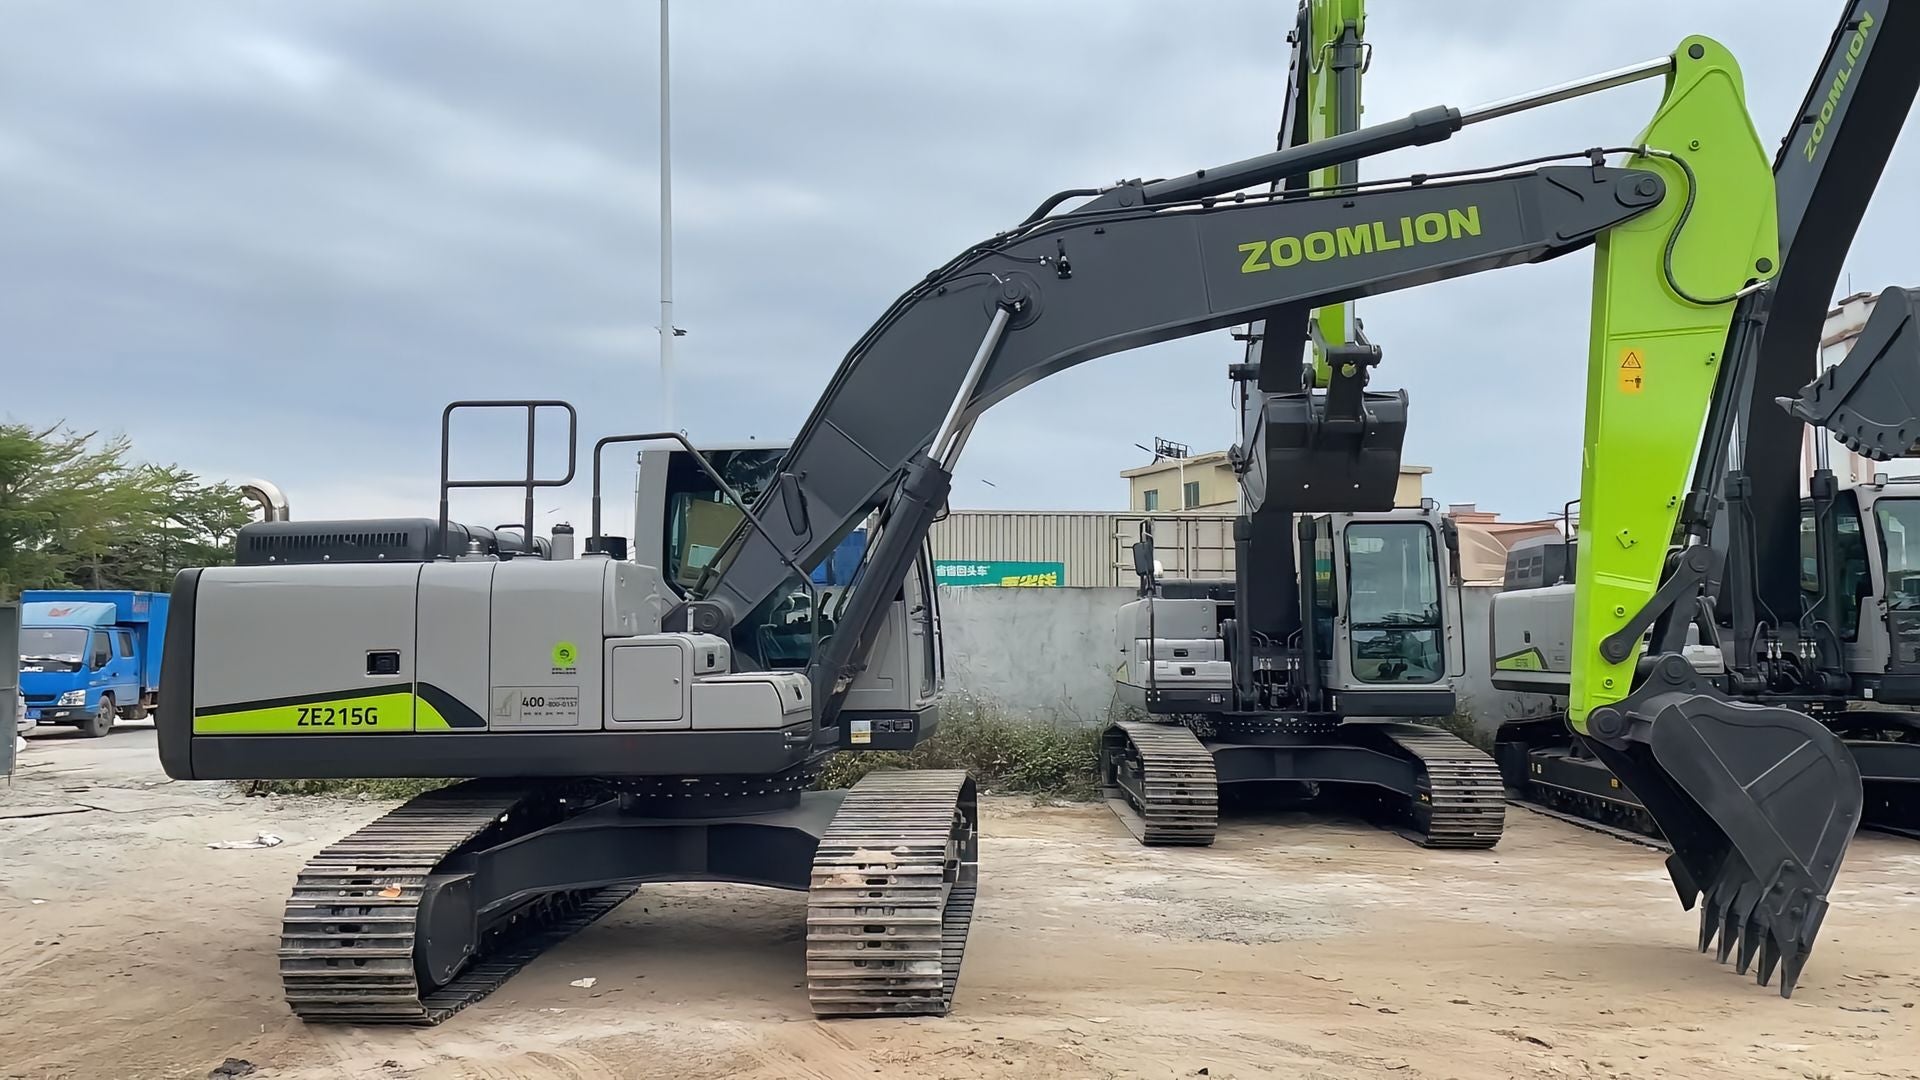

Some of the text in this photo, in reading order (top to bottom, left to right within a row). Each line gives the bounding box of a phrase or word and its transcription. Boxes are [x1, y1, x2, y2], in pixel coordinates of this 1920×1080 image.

[1803, 10, 1874, 163] ZOOMLION
[1238, 206, 1482, 274] ZOOMLION
[297, 707, 378, 726] ZE215G
